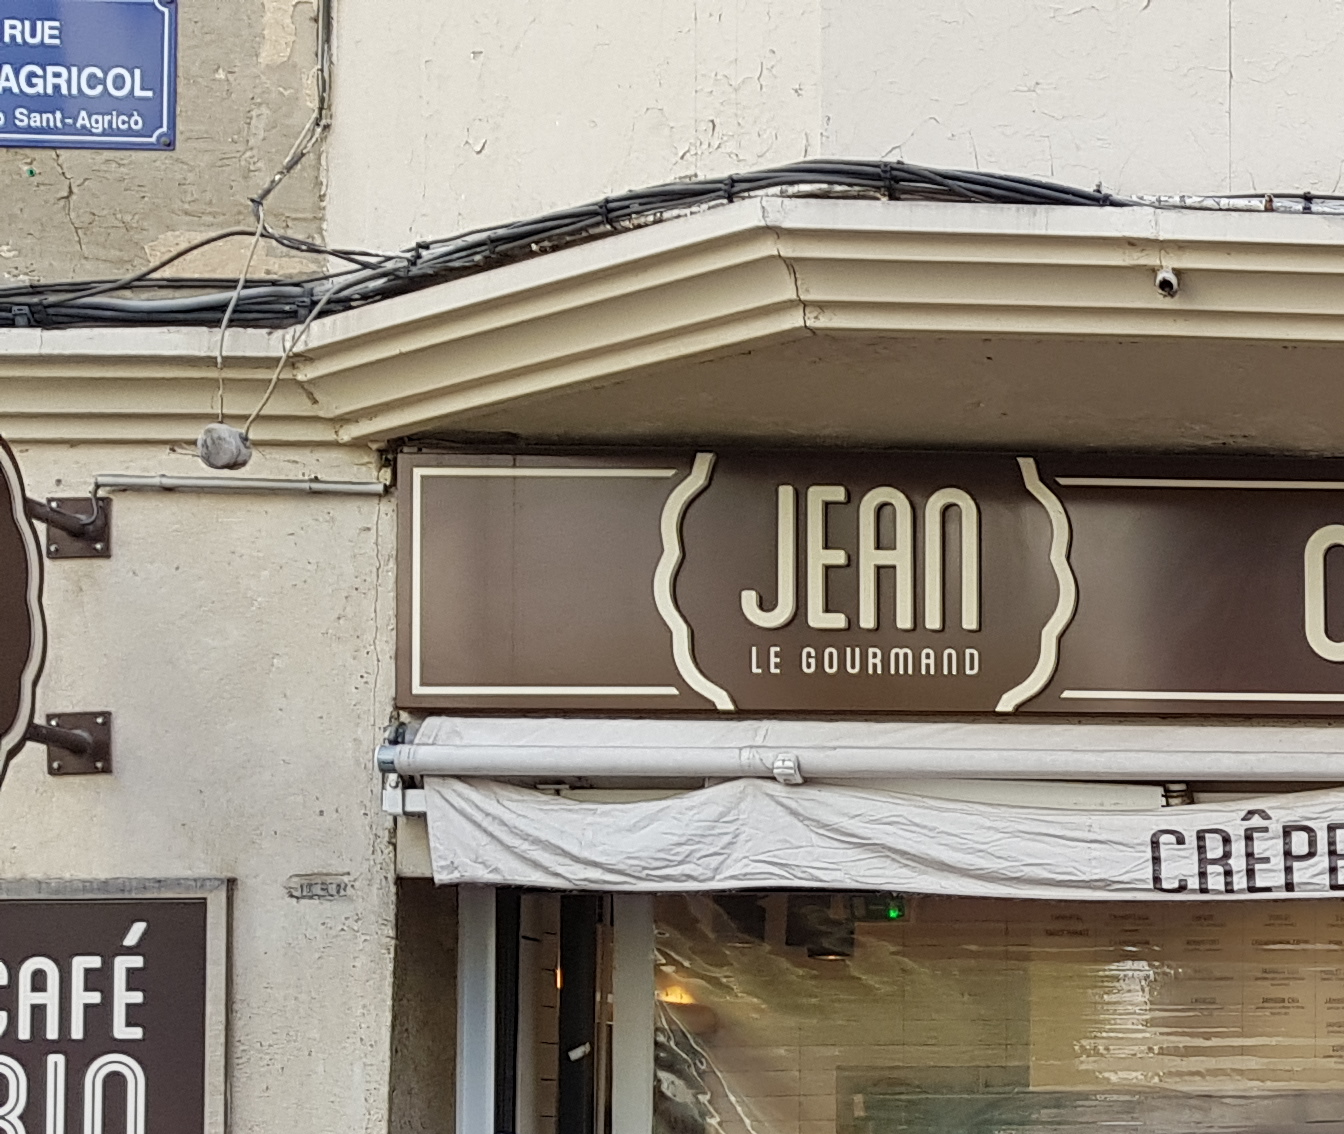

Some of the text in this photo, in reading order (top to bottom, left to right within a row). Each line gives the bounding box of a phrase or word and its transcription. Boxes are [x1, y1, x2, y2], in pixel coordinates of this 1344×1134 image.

[4, 19, 61, 45] RUE
[14, 108, 143, 133] Sant-Agricò
[740, 484, 980, 631] JEAN
[751, 646, 980, 675] LE GOURMAND
[0, 922, 149, 1041] AFÉ
